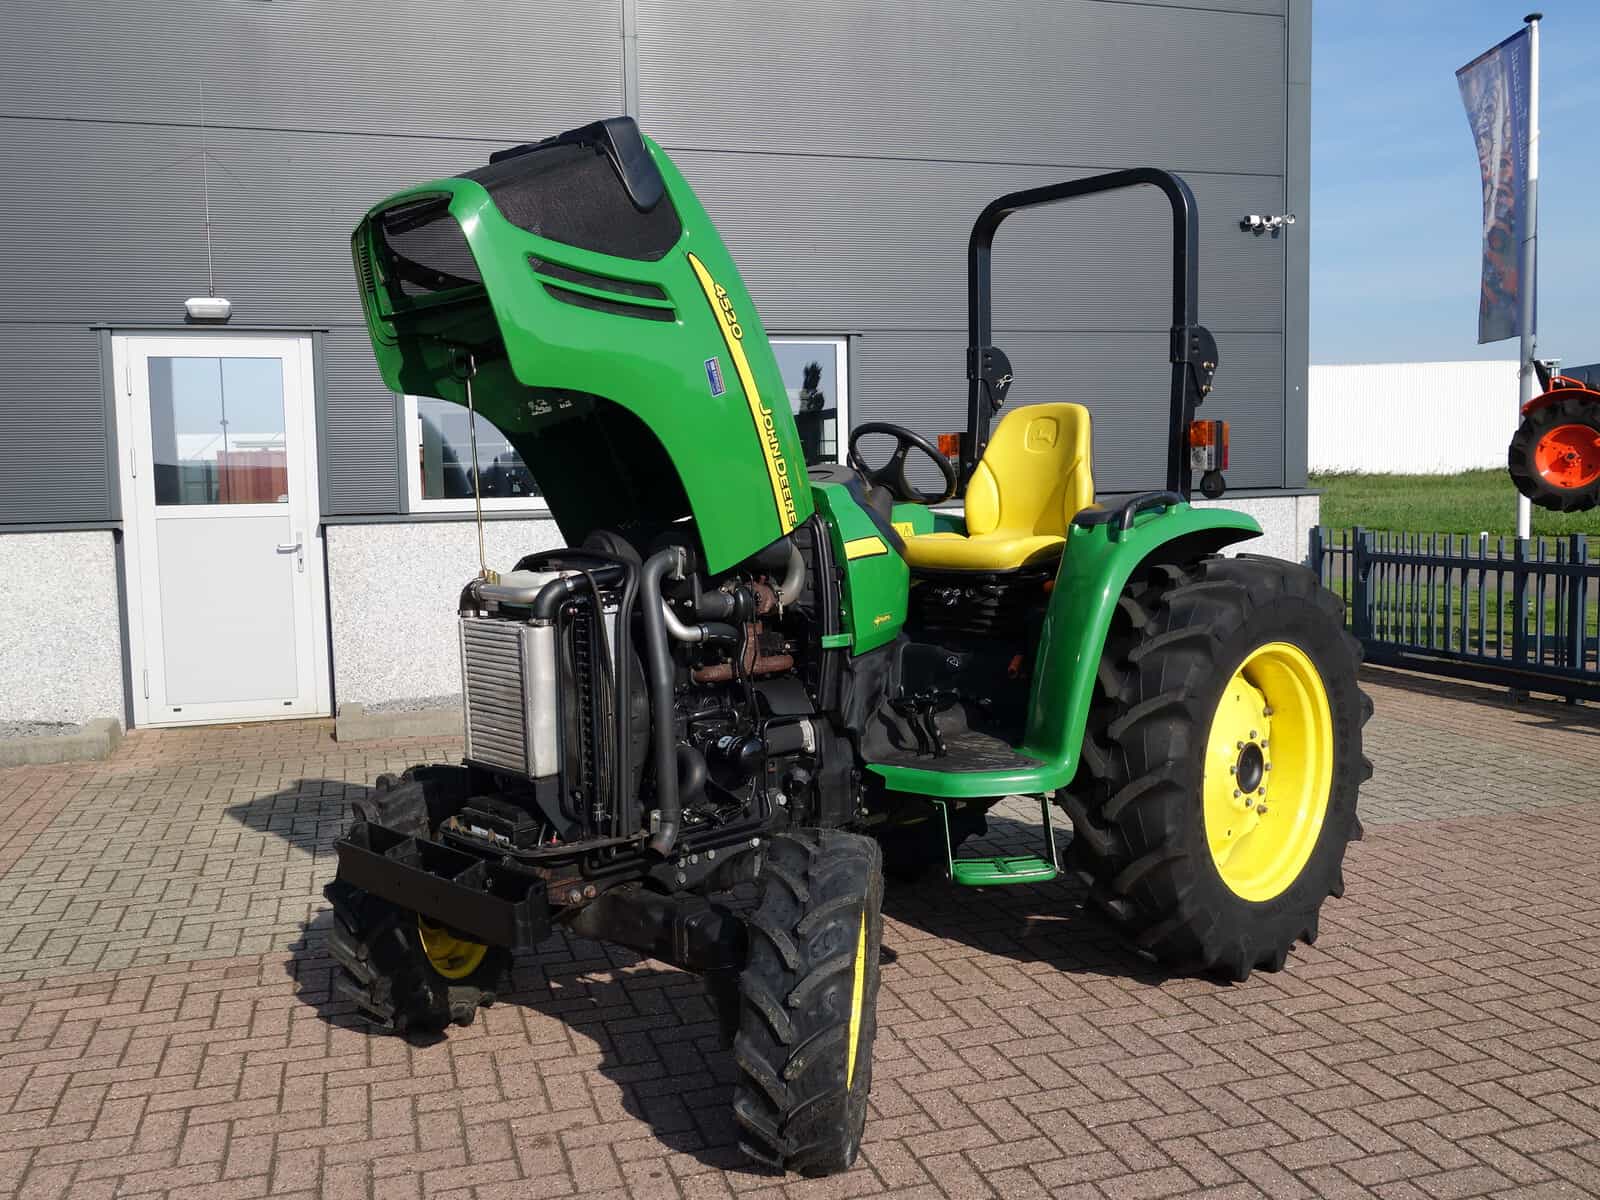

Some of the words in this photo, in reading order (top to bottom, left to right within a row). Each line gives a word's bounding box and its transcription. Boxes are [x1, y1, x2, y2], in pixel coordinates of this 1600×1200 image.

[714, 283, 743, 340] 4520
[759, 403, 782, 458] JOHN
[775, 457, 798, 525] DEERE
